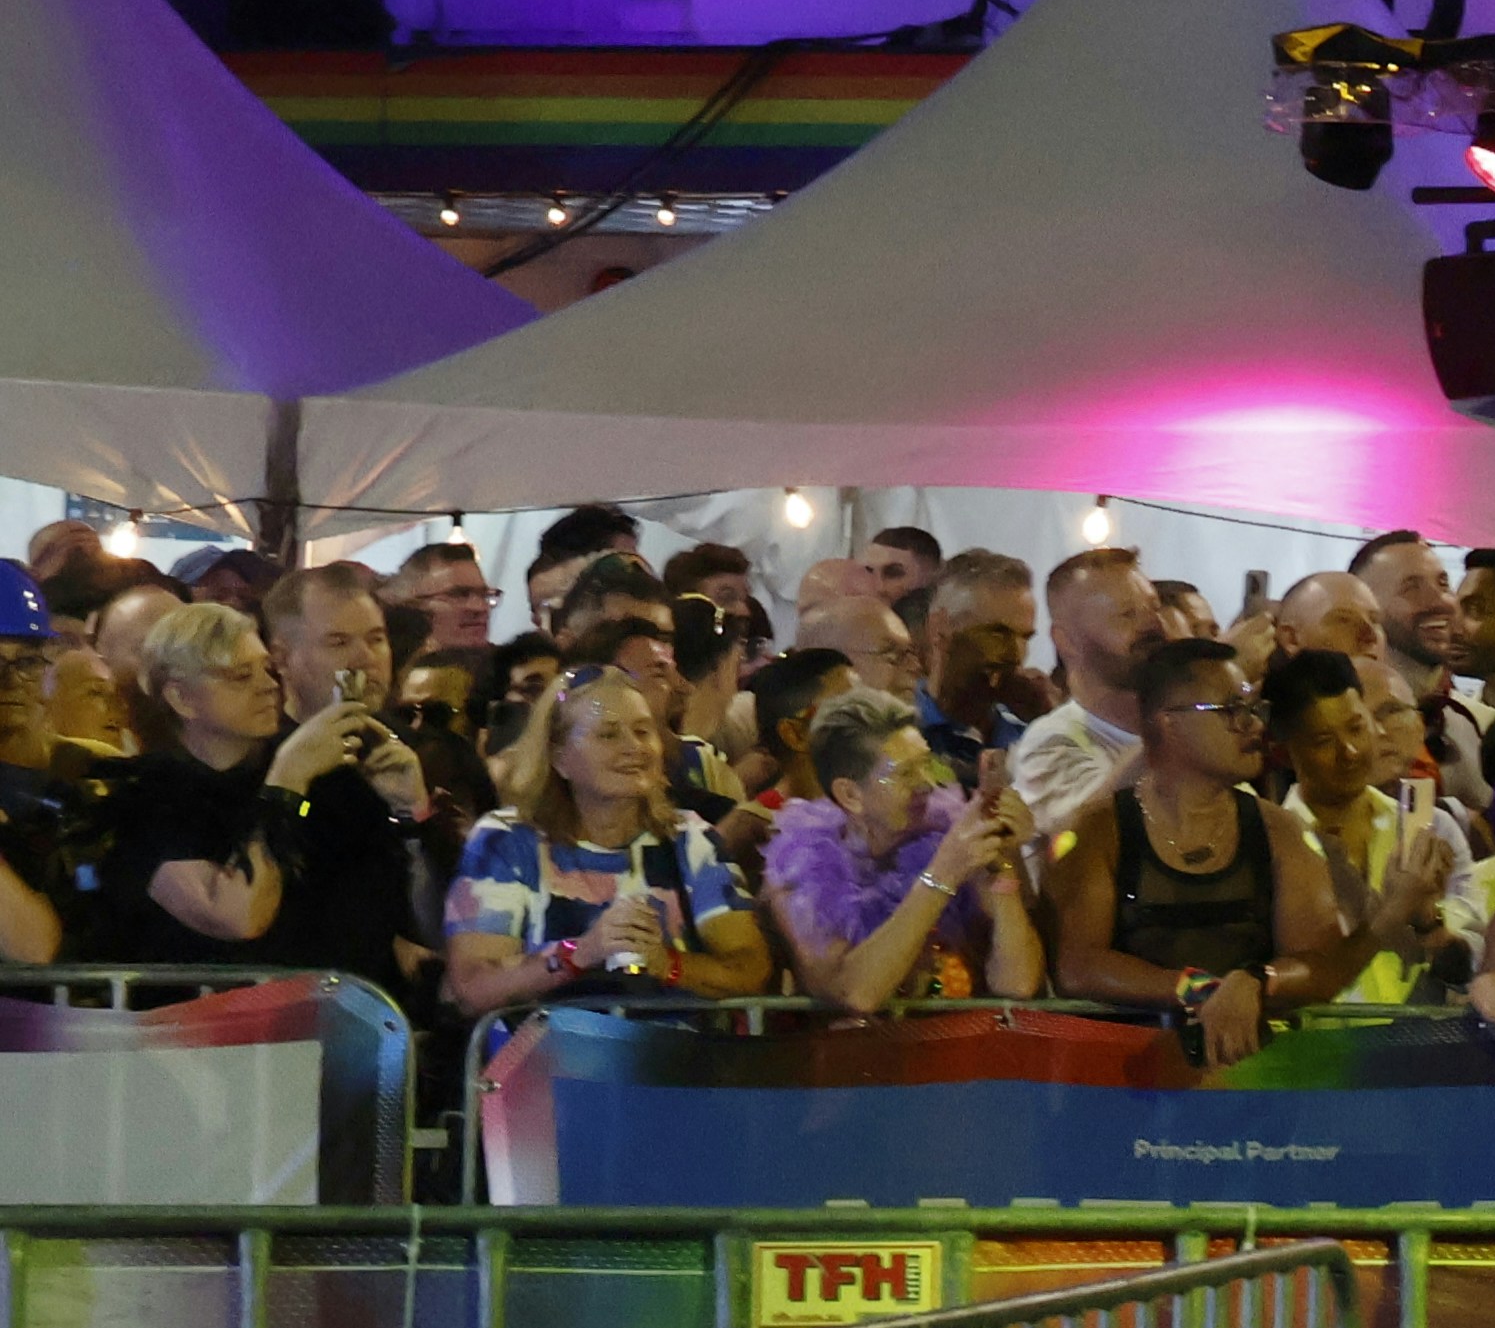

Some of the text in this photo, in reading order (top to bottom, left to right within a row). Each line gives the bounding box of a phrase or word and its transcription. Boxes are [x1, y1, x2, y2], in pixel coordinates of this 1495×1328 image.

[1134, 1138, 1341, 1164] Principal Partner
[775, 1253, 907, 1301] TFH
